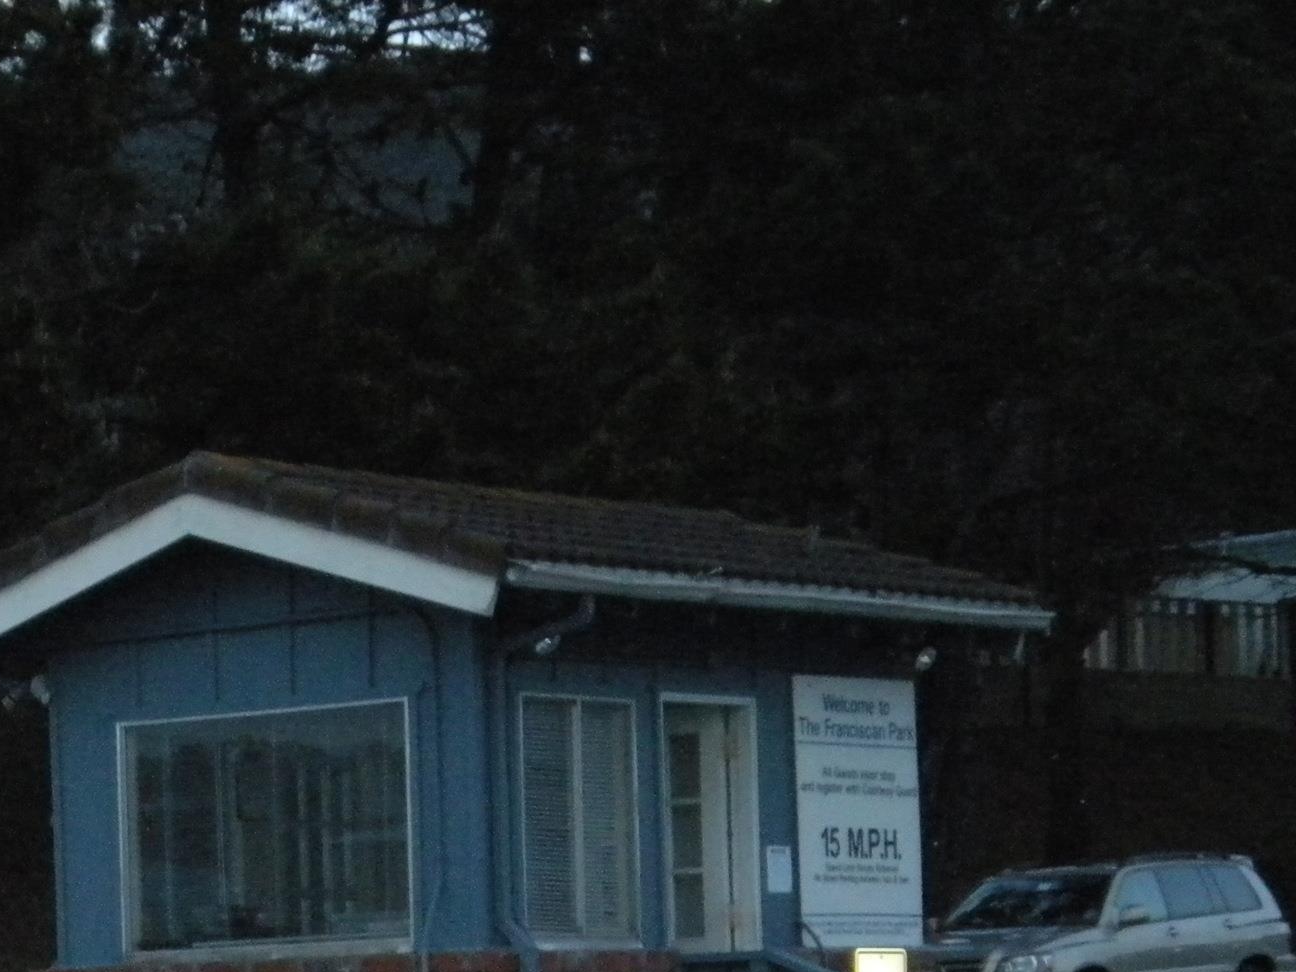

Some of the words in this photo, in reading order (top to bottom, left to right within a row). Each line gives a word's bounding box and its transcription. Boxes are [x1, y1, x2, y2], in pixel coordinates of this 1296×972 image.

[823, 693, 874, 714] Welcome
[878, 700, 891, 716] to
[799, 716, 821, 736] The
[824, 718, 886, 740] Franciscan
[888, 722, 914, 742] Park
[821, 827, 841, 859] 15
[847, 827, 902, 860] M.P.H.
